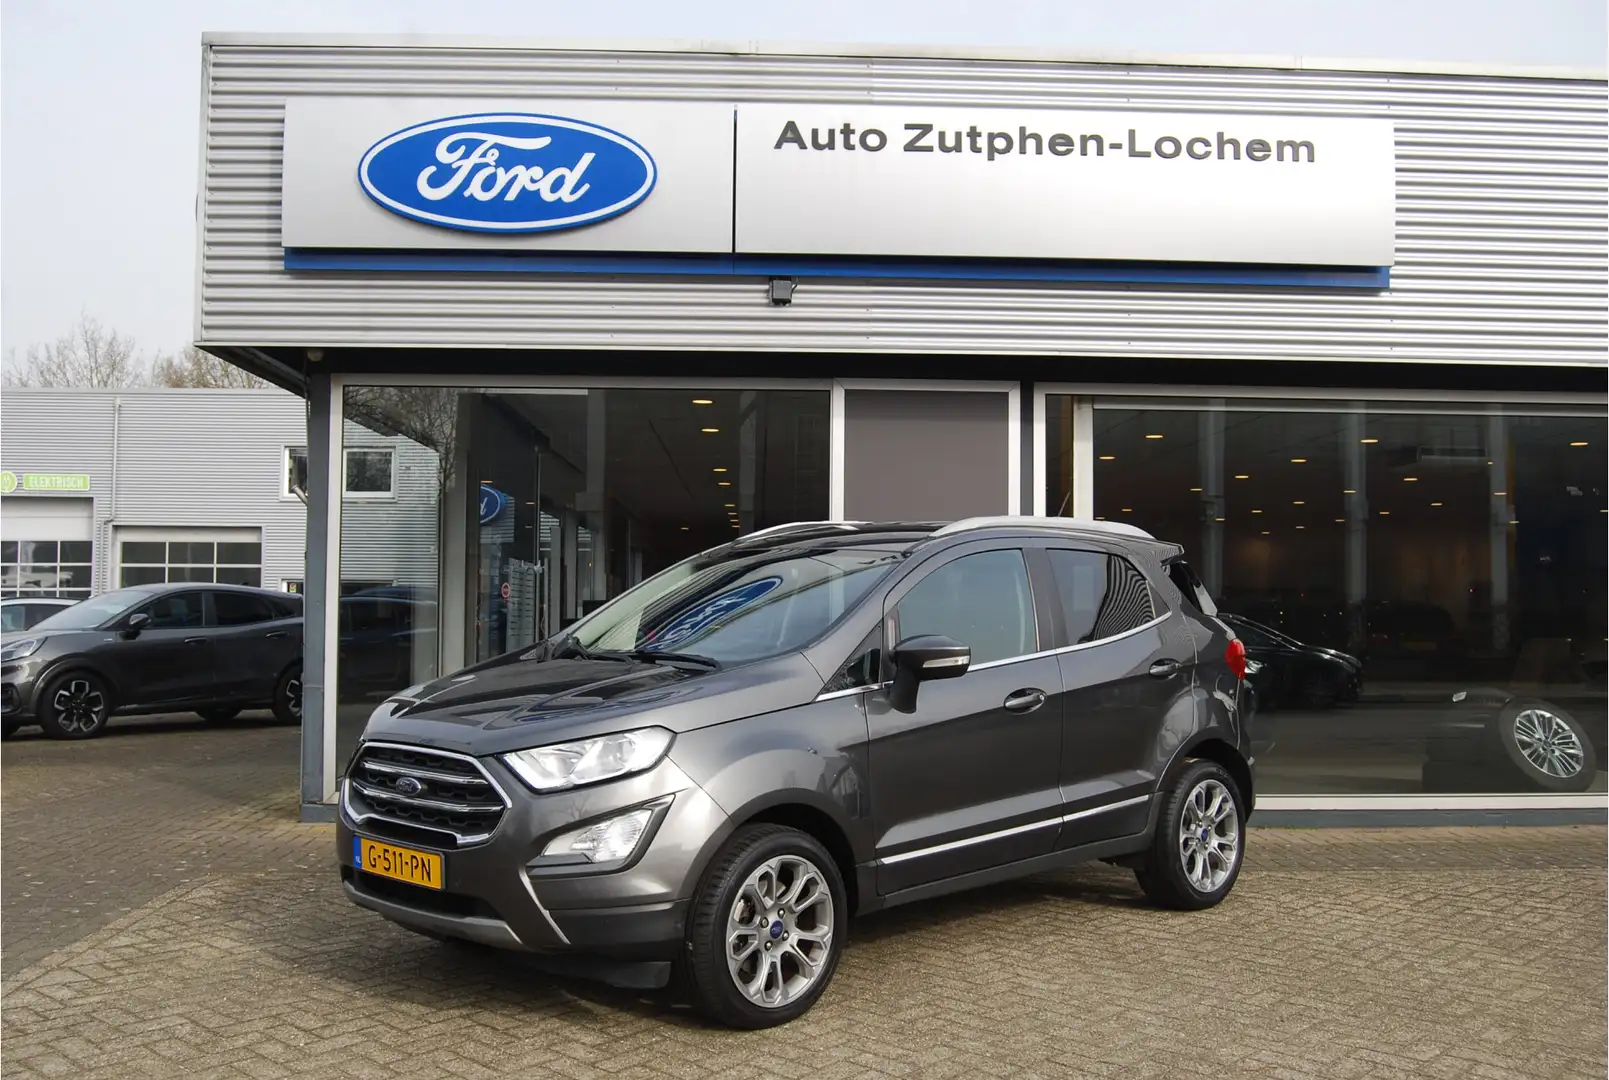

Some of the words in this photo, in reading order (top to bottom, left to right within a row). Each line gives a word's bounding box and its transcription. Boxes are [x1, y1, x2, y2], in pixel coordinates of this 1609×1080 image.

[774, 120, 888, 152] Auto
[903, 123, 1316, 163] Zutphen-Lochem
[416, 132, 596, 203] Ford
[368, 844, 432, 883] G-511-PN
